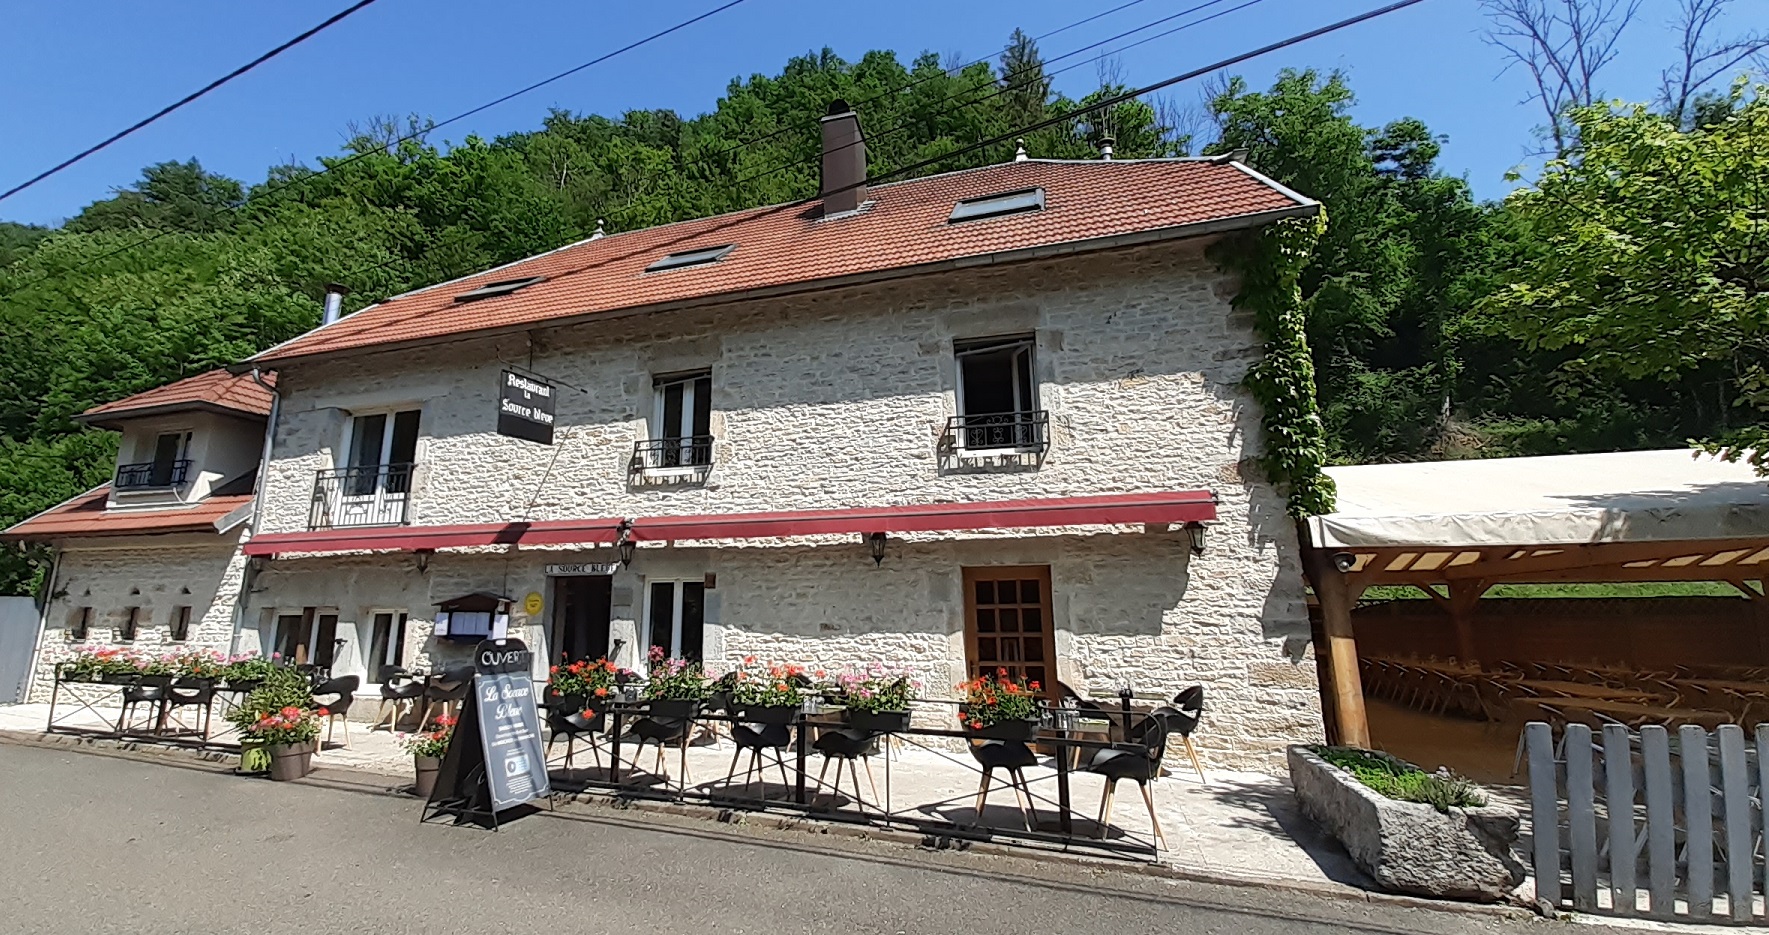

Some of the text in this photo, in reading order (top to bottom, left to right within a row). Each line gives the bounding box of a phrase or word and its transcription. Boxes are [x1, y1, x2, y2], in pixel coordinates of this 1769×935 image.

[507, 372, 550, 397] Restaurant
[502, 398, 531, 416] Source
[558, 565, 586, 573] SOURCE
[482, 651, 526, 666] OUVERT
[484, 686, 498, 702] La
